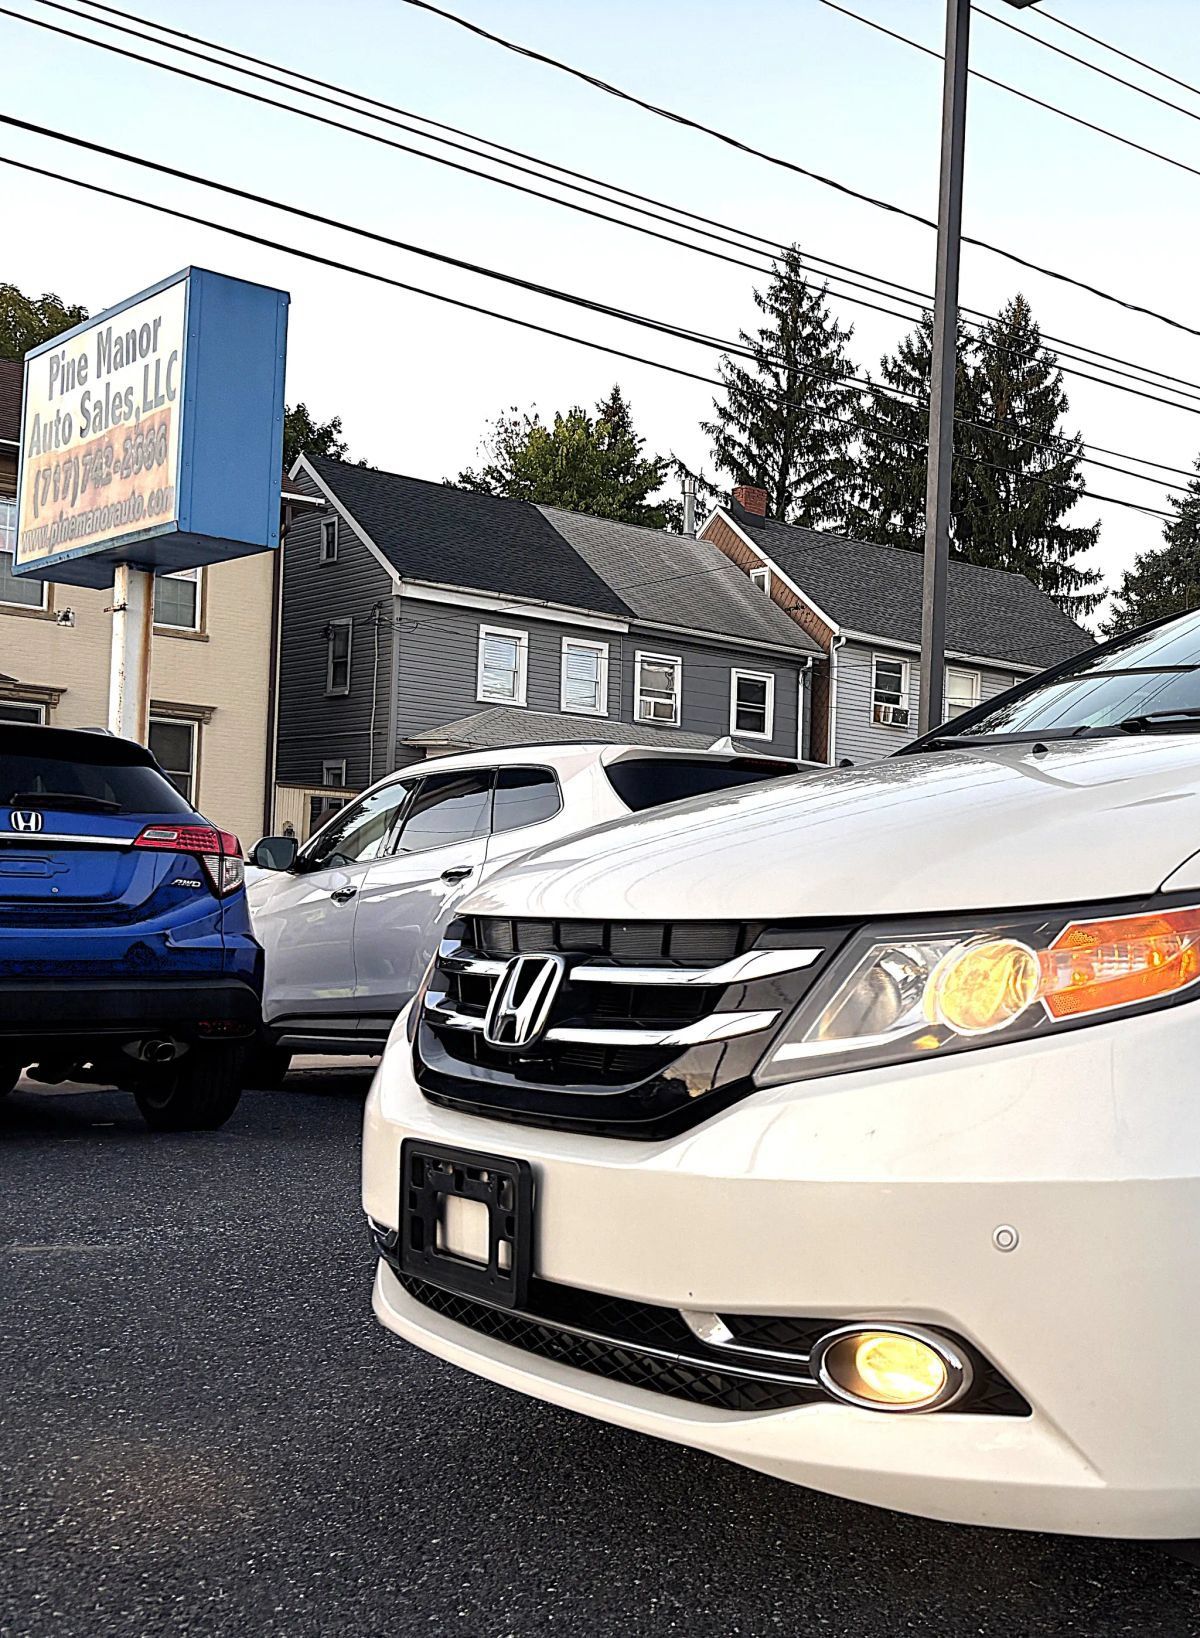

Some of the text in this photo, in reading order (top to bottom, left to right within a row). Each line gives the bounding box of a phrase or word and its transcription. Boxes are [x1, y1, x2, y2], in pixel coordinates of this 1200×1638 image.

[49, 315, 162, 401] Pine Manor
[28, 409, 73, 458] Auto
[171, 879, 201, 887] AWD
